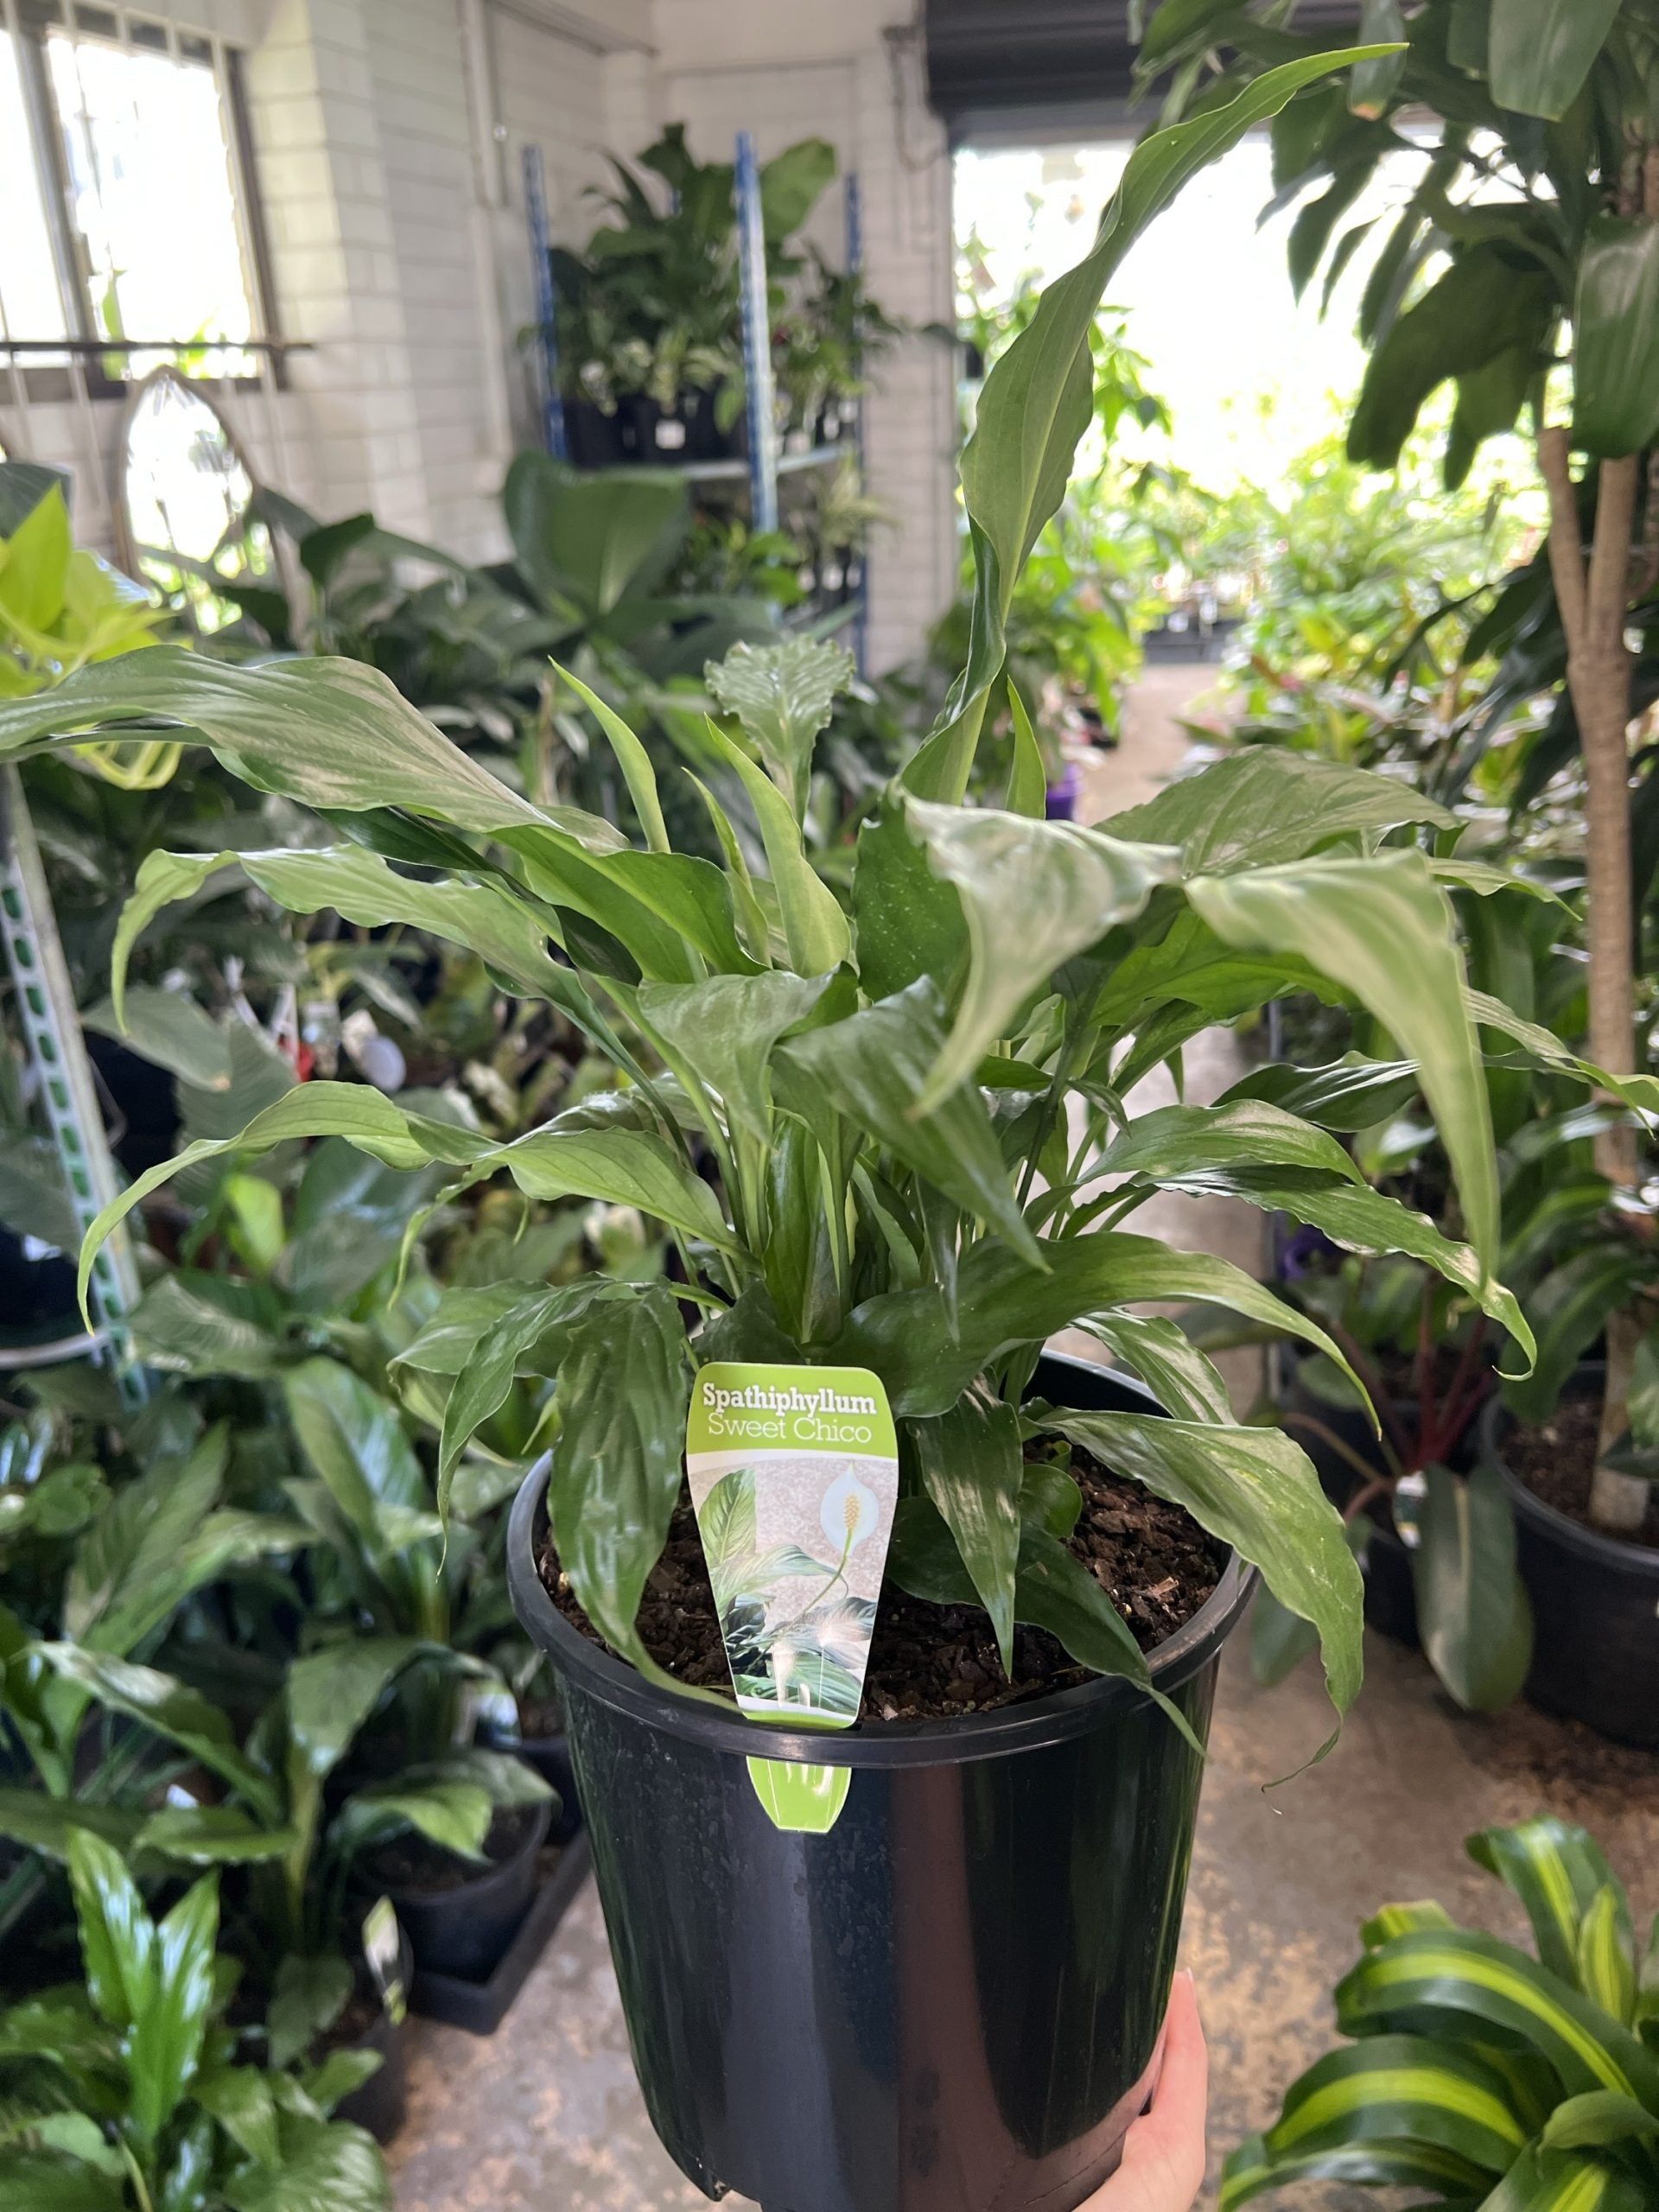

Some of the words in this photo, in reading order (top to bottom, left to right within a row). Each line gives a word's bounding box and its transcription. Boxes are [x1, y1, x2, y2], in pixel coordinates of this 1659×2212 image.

[702, 1382, 878, 1419] Spathiphyllum
[708, 1412, 787, 1440] Sweet
[793, 1416, 873, 1444] Chico
